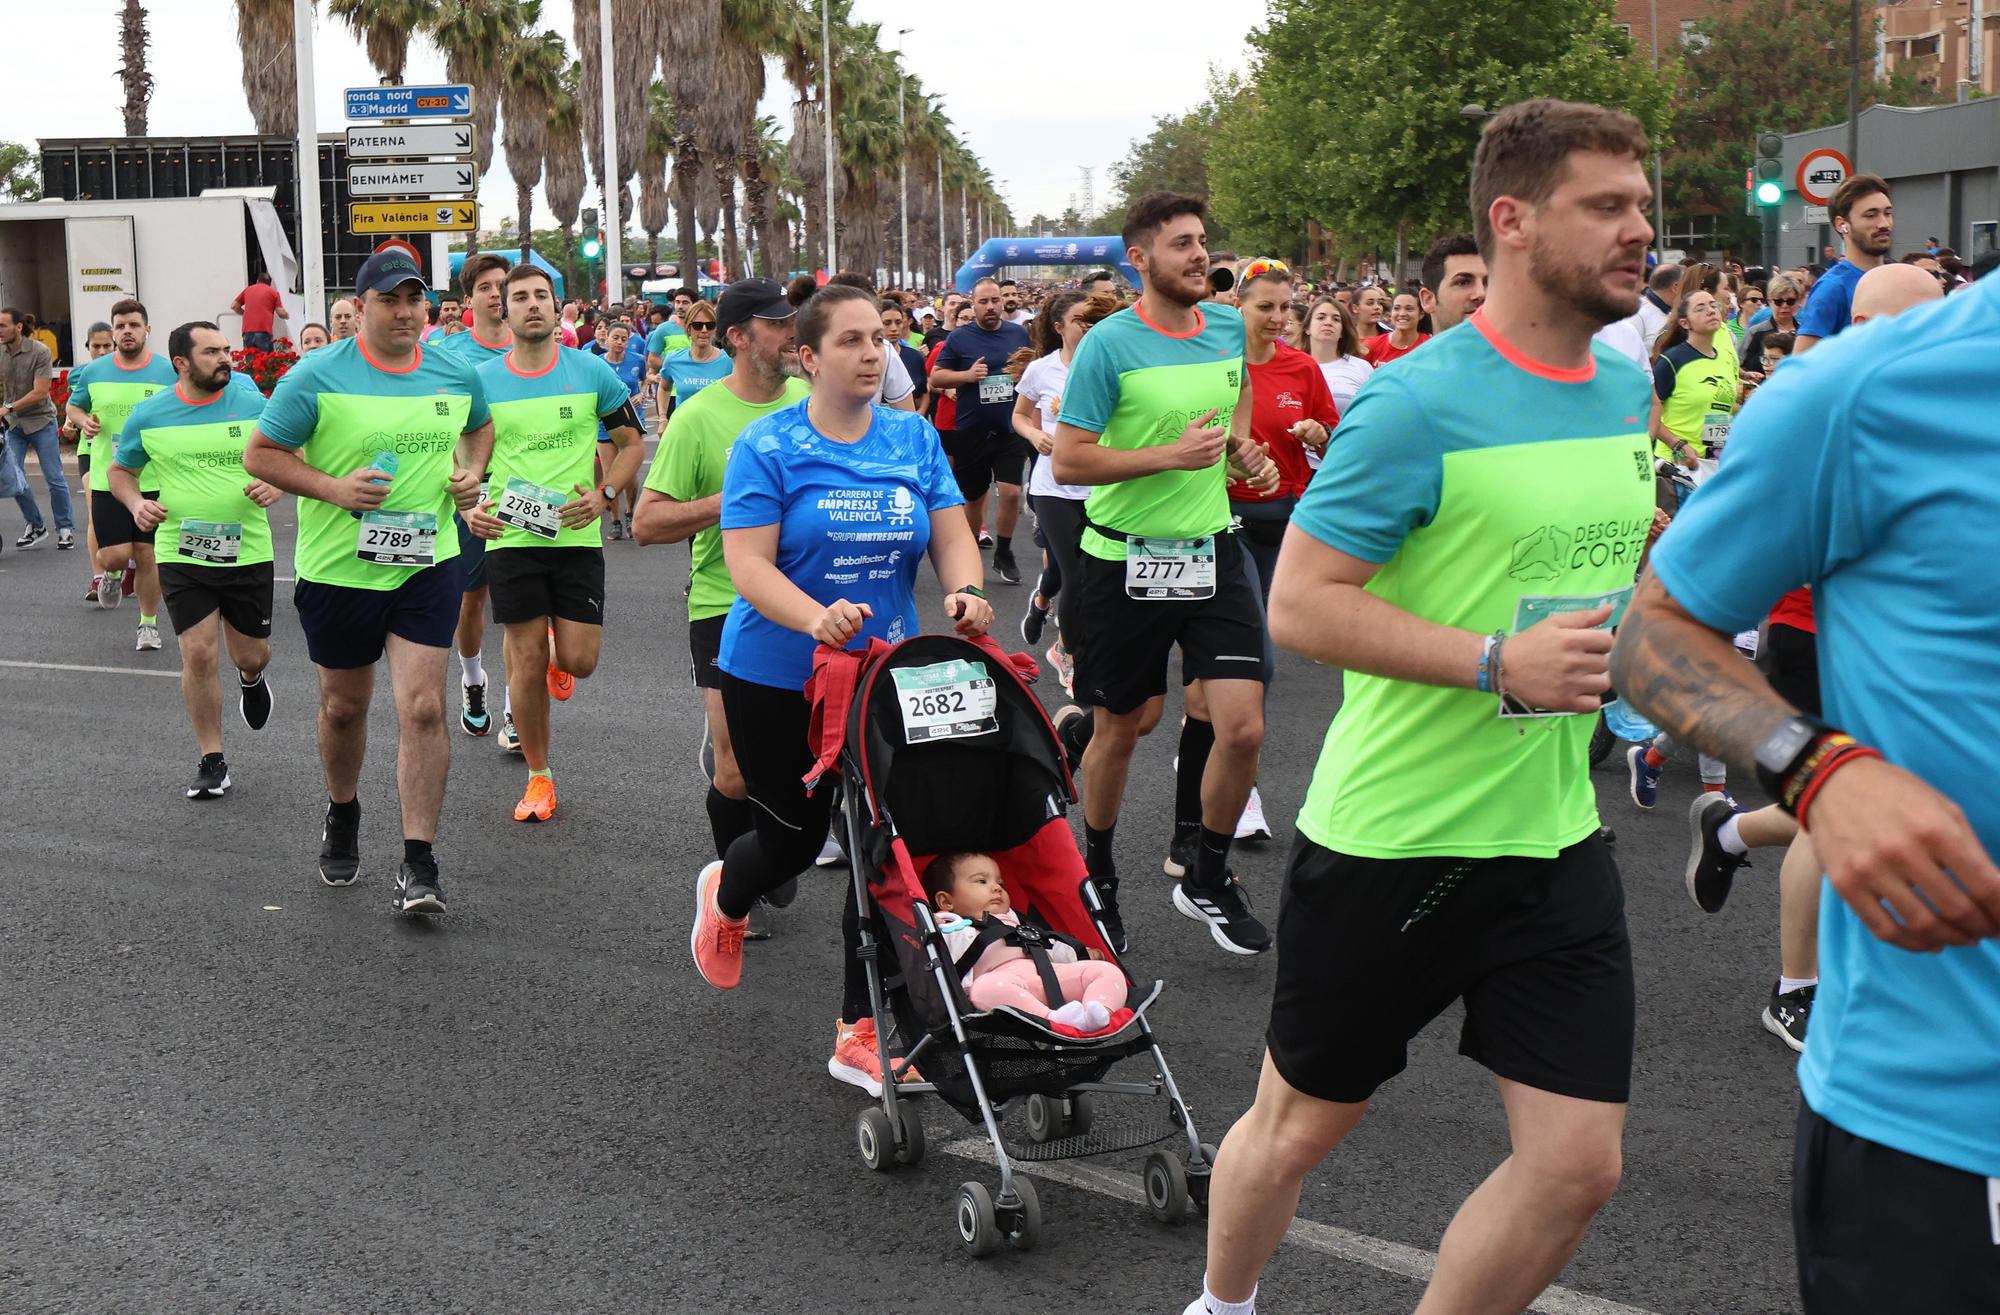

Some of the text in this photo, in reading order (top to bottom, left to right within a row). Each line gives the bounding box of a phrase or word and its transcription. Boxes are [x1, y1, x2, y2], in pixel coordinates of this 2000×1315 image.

[348, 90, 413, 101] ronda nord
[418, 98, 448, 107] CV-30
[350, 103, 408, 114] A-3 Madrid
[350, 136, 406, 147] PATERNA
[352, 172, 424, 185] BENIMÀMET
[353, 213, 374, 223] Fira
[984, 385, 1005, 395] 1720
[396, 431, 451, 442] DESGUACE
[528, 430, 573, 441] DESGUACE
[395, 441, 449, 454] CORTES
[528, 437, 573, 450] CORTES
[827, 490, 884, 499] X CARRERA DE
[506, 495, 541, 518] 2788
[817, 499, 878, 511] EMPRESAS
[829, 511, 882, 522] VALENCIA
[185, 535, 221, 551] 2782
[366, 529, 412, 548] 2789
[1571, 540, 1643, 570] CORTE
[833, 554, 888, 568] globalfactor
[1135, 561, 1186, 579] 2777
[975, 680, 988, 688] 5K
[909, 691, 967, 717] 2682
